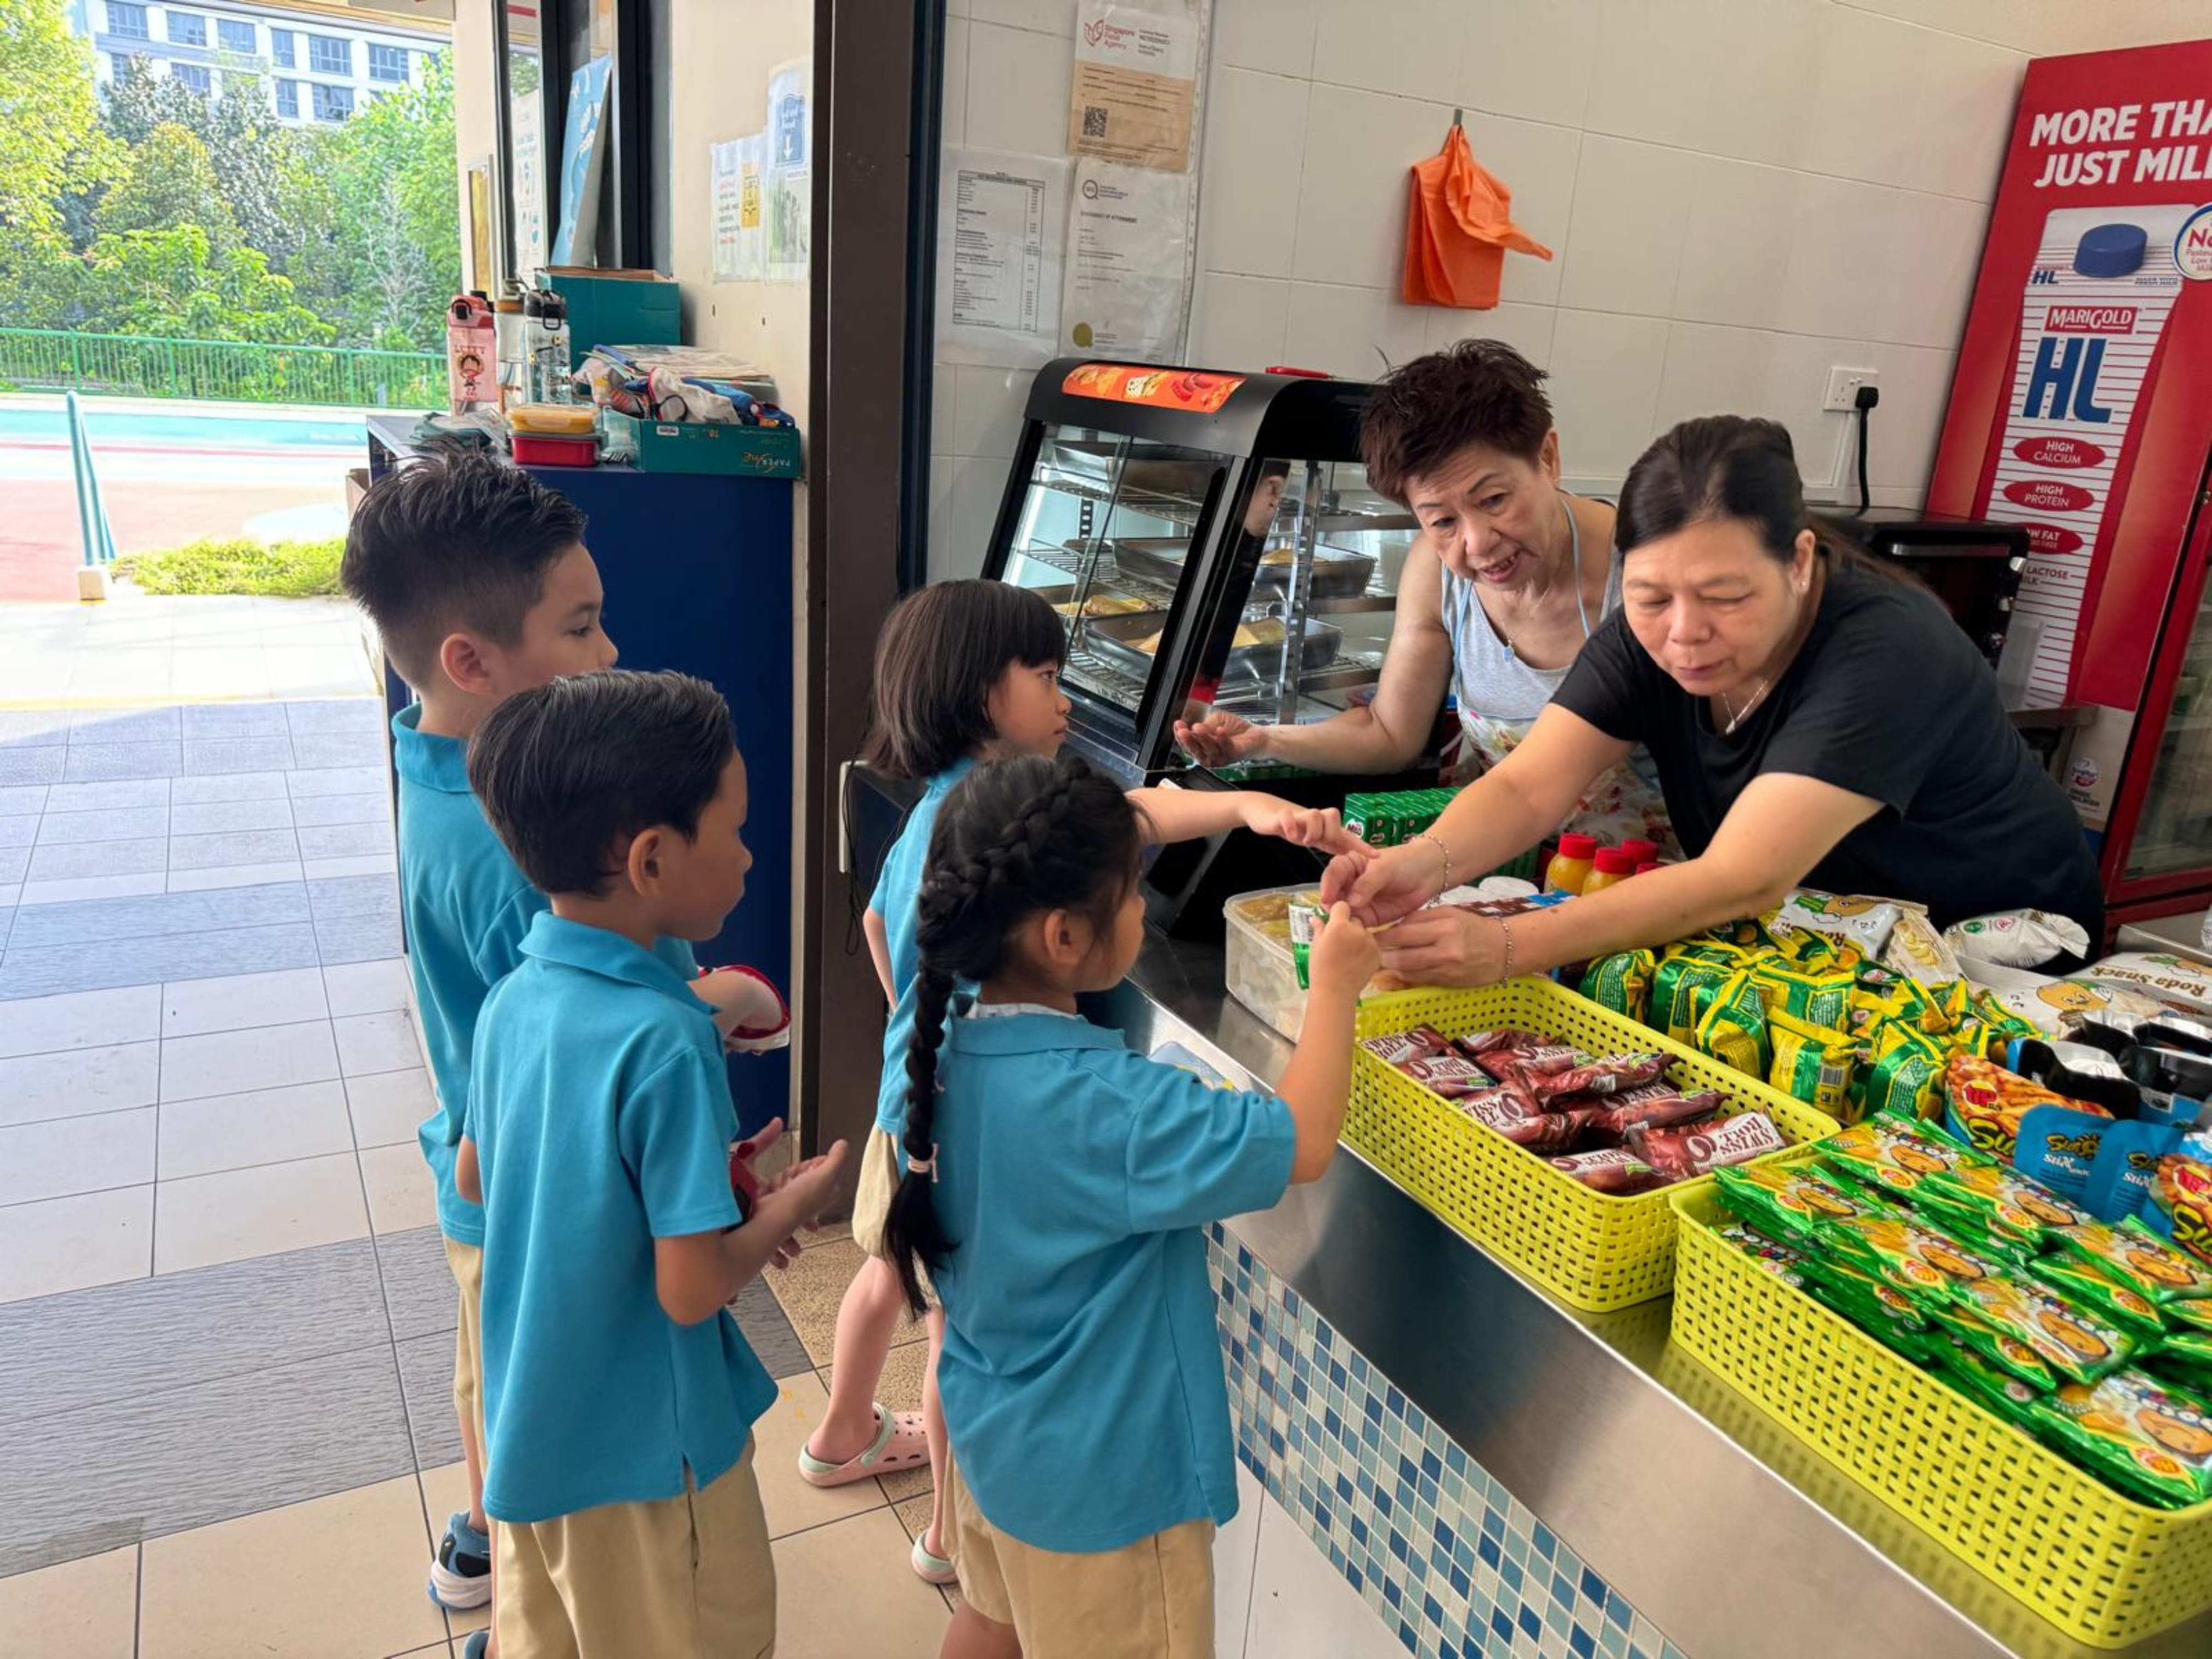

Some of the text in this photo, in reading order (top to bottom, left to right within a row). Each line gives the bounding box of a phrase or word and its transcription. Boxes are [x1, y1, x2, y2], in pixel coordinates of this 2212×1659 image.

[2029, 105, 2142, 147] MORE
[2033, 145, 2212, 188] JUST MIL
[2032, 270, 2059, 284] HL
[2050, 308, 2132, 329] MARIGOLD
[2023, 337, 2112, 424] HL
[2046, 440, 2074, 452] HIGH
[2034, 451, 2081, 464] CALCIUM
[2035, 484, 2064, 495] HIGH
[2024, 494, 2069, 507] PROTEIN
[2041, 530, 2062, 541] FAT
[2027, 565, 2069, 580] LACTOSE
[2091, 967, 2206, 998] Roda Snack
[1719, 1116, 1763, 1142] ROLL
[1719, 1126, 1775, 1154] SWISS
